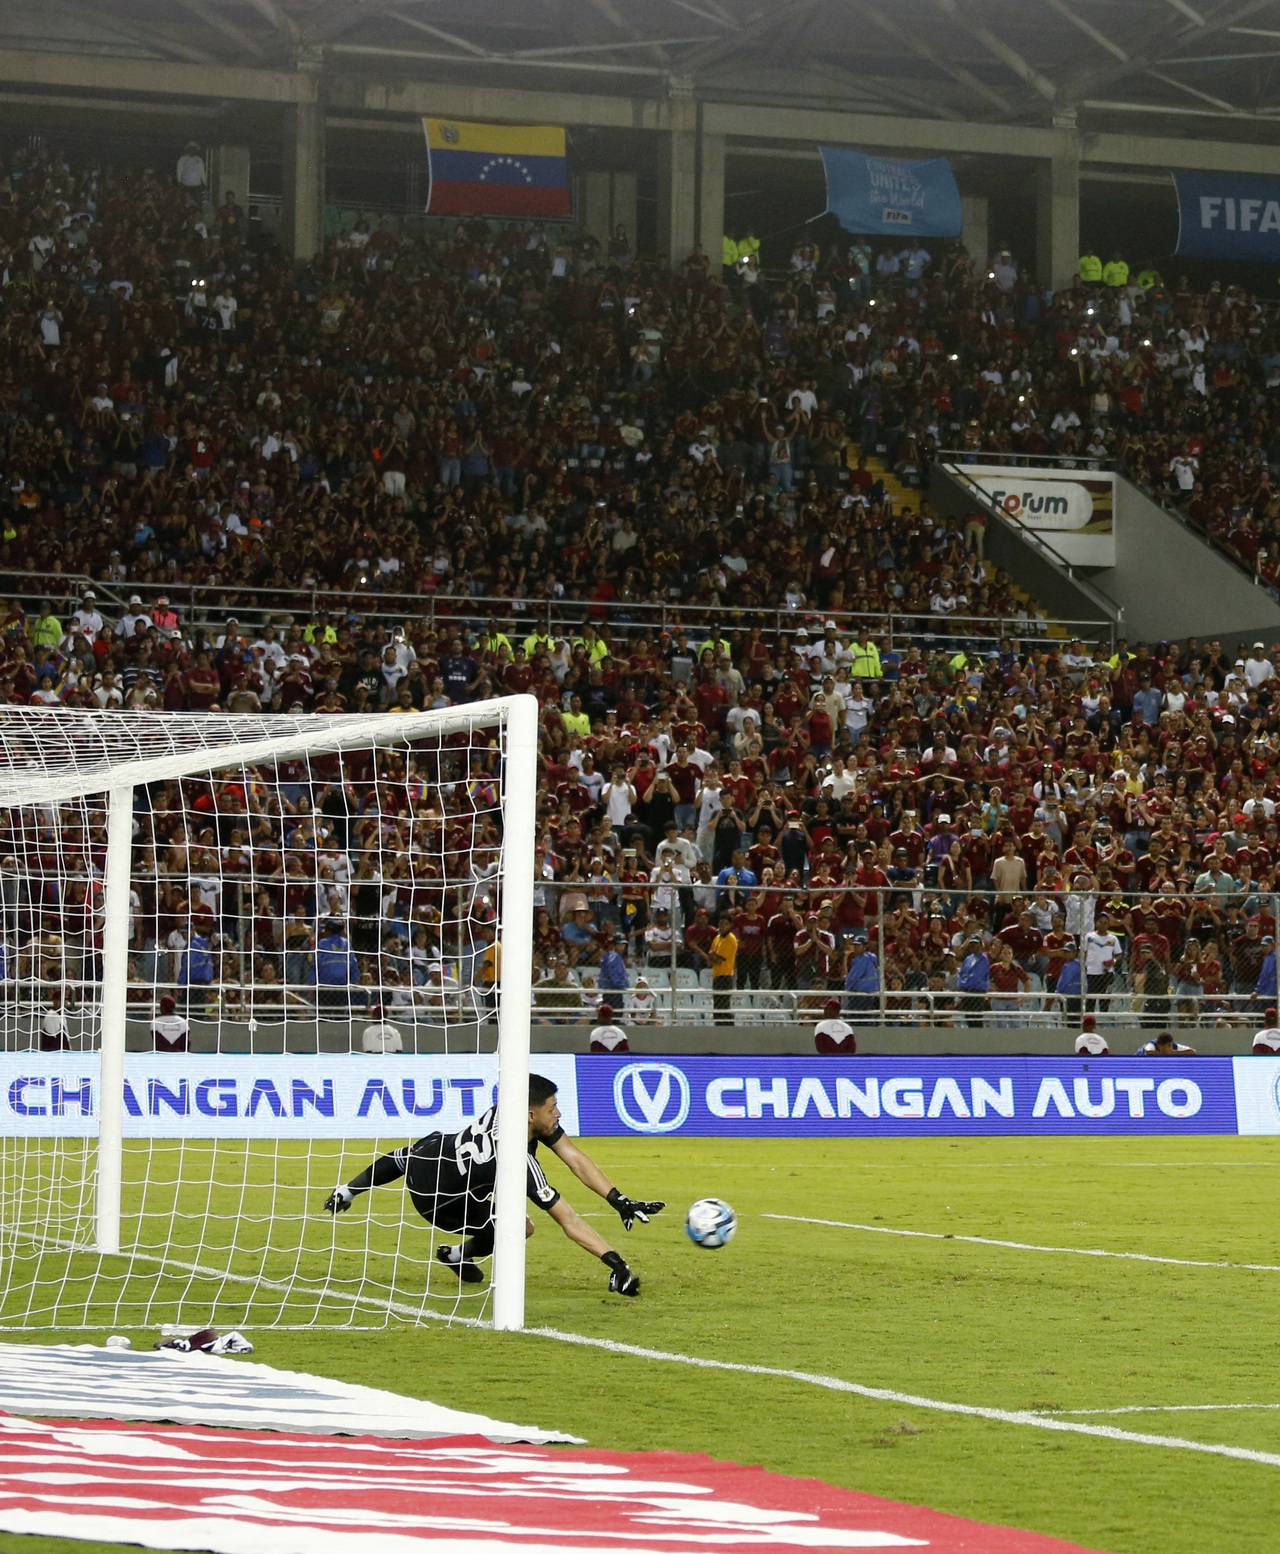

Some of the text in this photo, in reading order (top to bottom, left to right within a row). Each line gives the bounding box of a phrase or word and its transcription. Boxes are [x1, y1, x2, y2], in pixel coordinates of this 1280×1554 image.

[870, 171, 923, 193] UNITES
[886, 211, 909, 221] FIFA
[991, 491, 1068, 515] Forum
[358, 1077, 499, 1117] AUT
[705, 1077, 1203, 1119] CHANGAN AUTO
